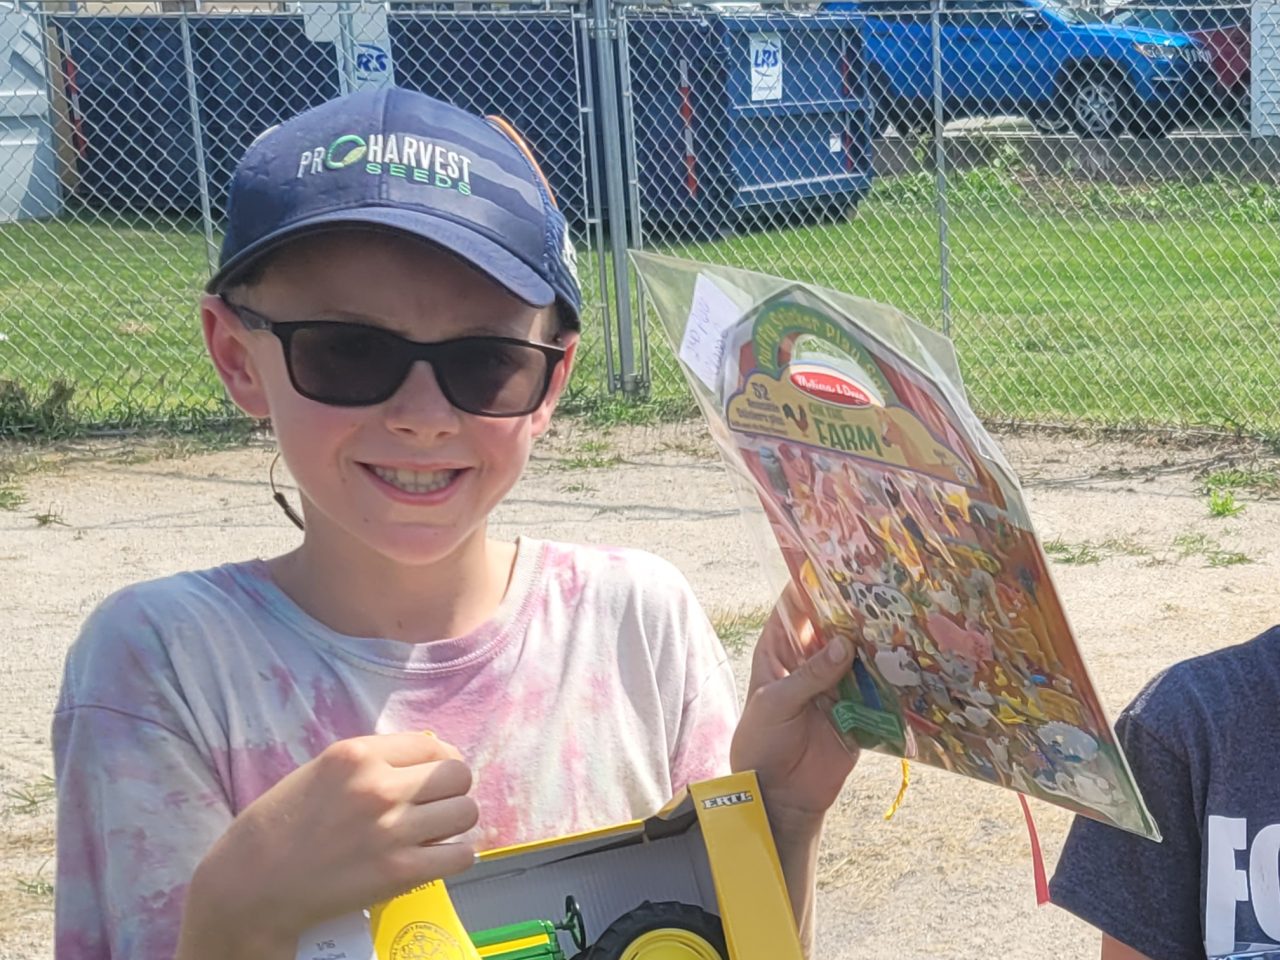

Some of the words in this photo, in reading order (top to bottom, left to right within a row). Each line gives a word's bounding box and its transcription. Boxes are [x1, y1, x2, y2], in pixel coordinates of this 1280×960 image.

[357, 53, 388, 72] RS
[754, 49, 779, 68] LRS
[365, 163, 472, 196] SEEDS
[813, 417, 884, 457] FARM
[703, 791, 753, 809] ERTL
